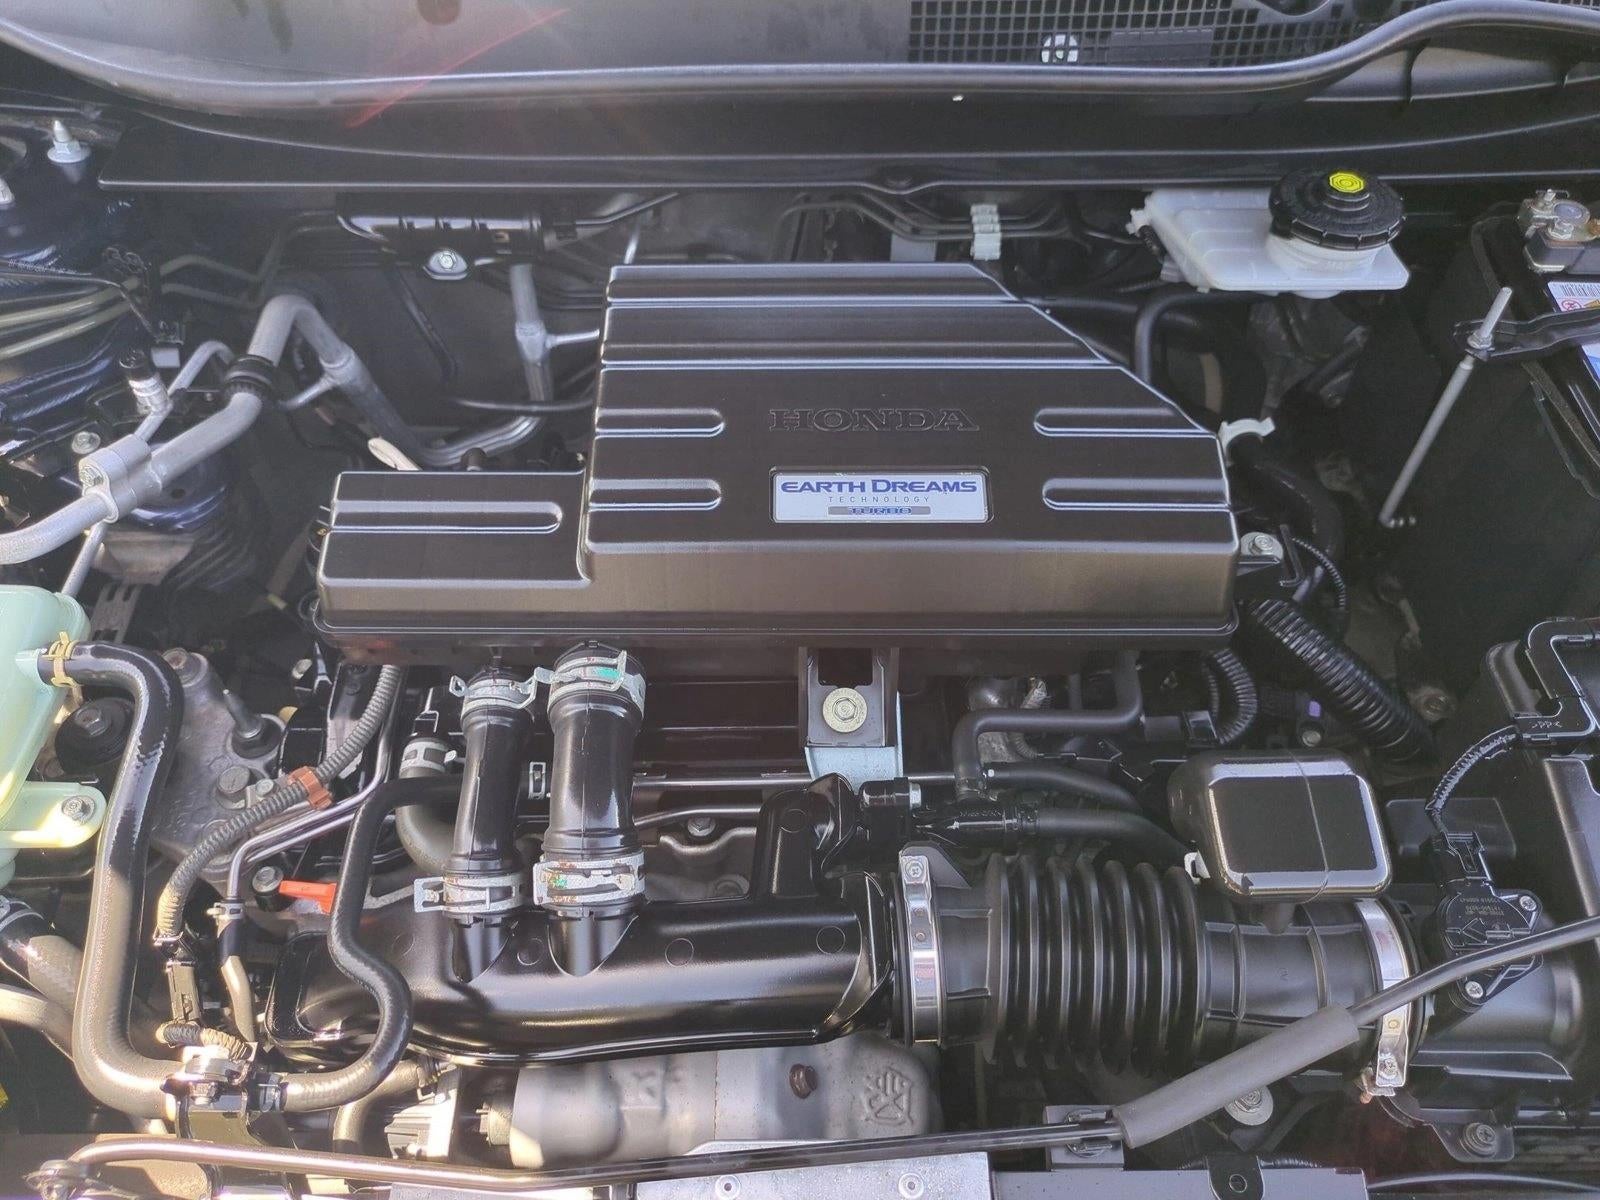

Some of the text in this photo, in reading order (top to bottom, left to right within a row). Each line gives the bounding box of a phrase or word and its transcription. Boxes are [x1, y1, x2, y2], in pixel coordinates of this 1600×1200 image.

[768, 408, 980, 432] HONDA
[780, 479, 978, 493] EARTH DREAMS
